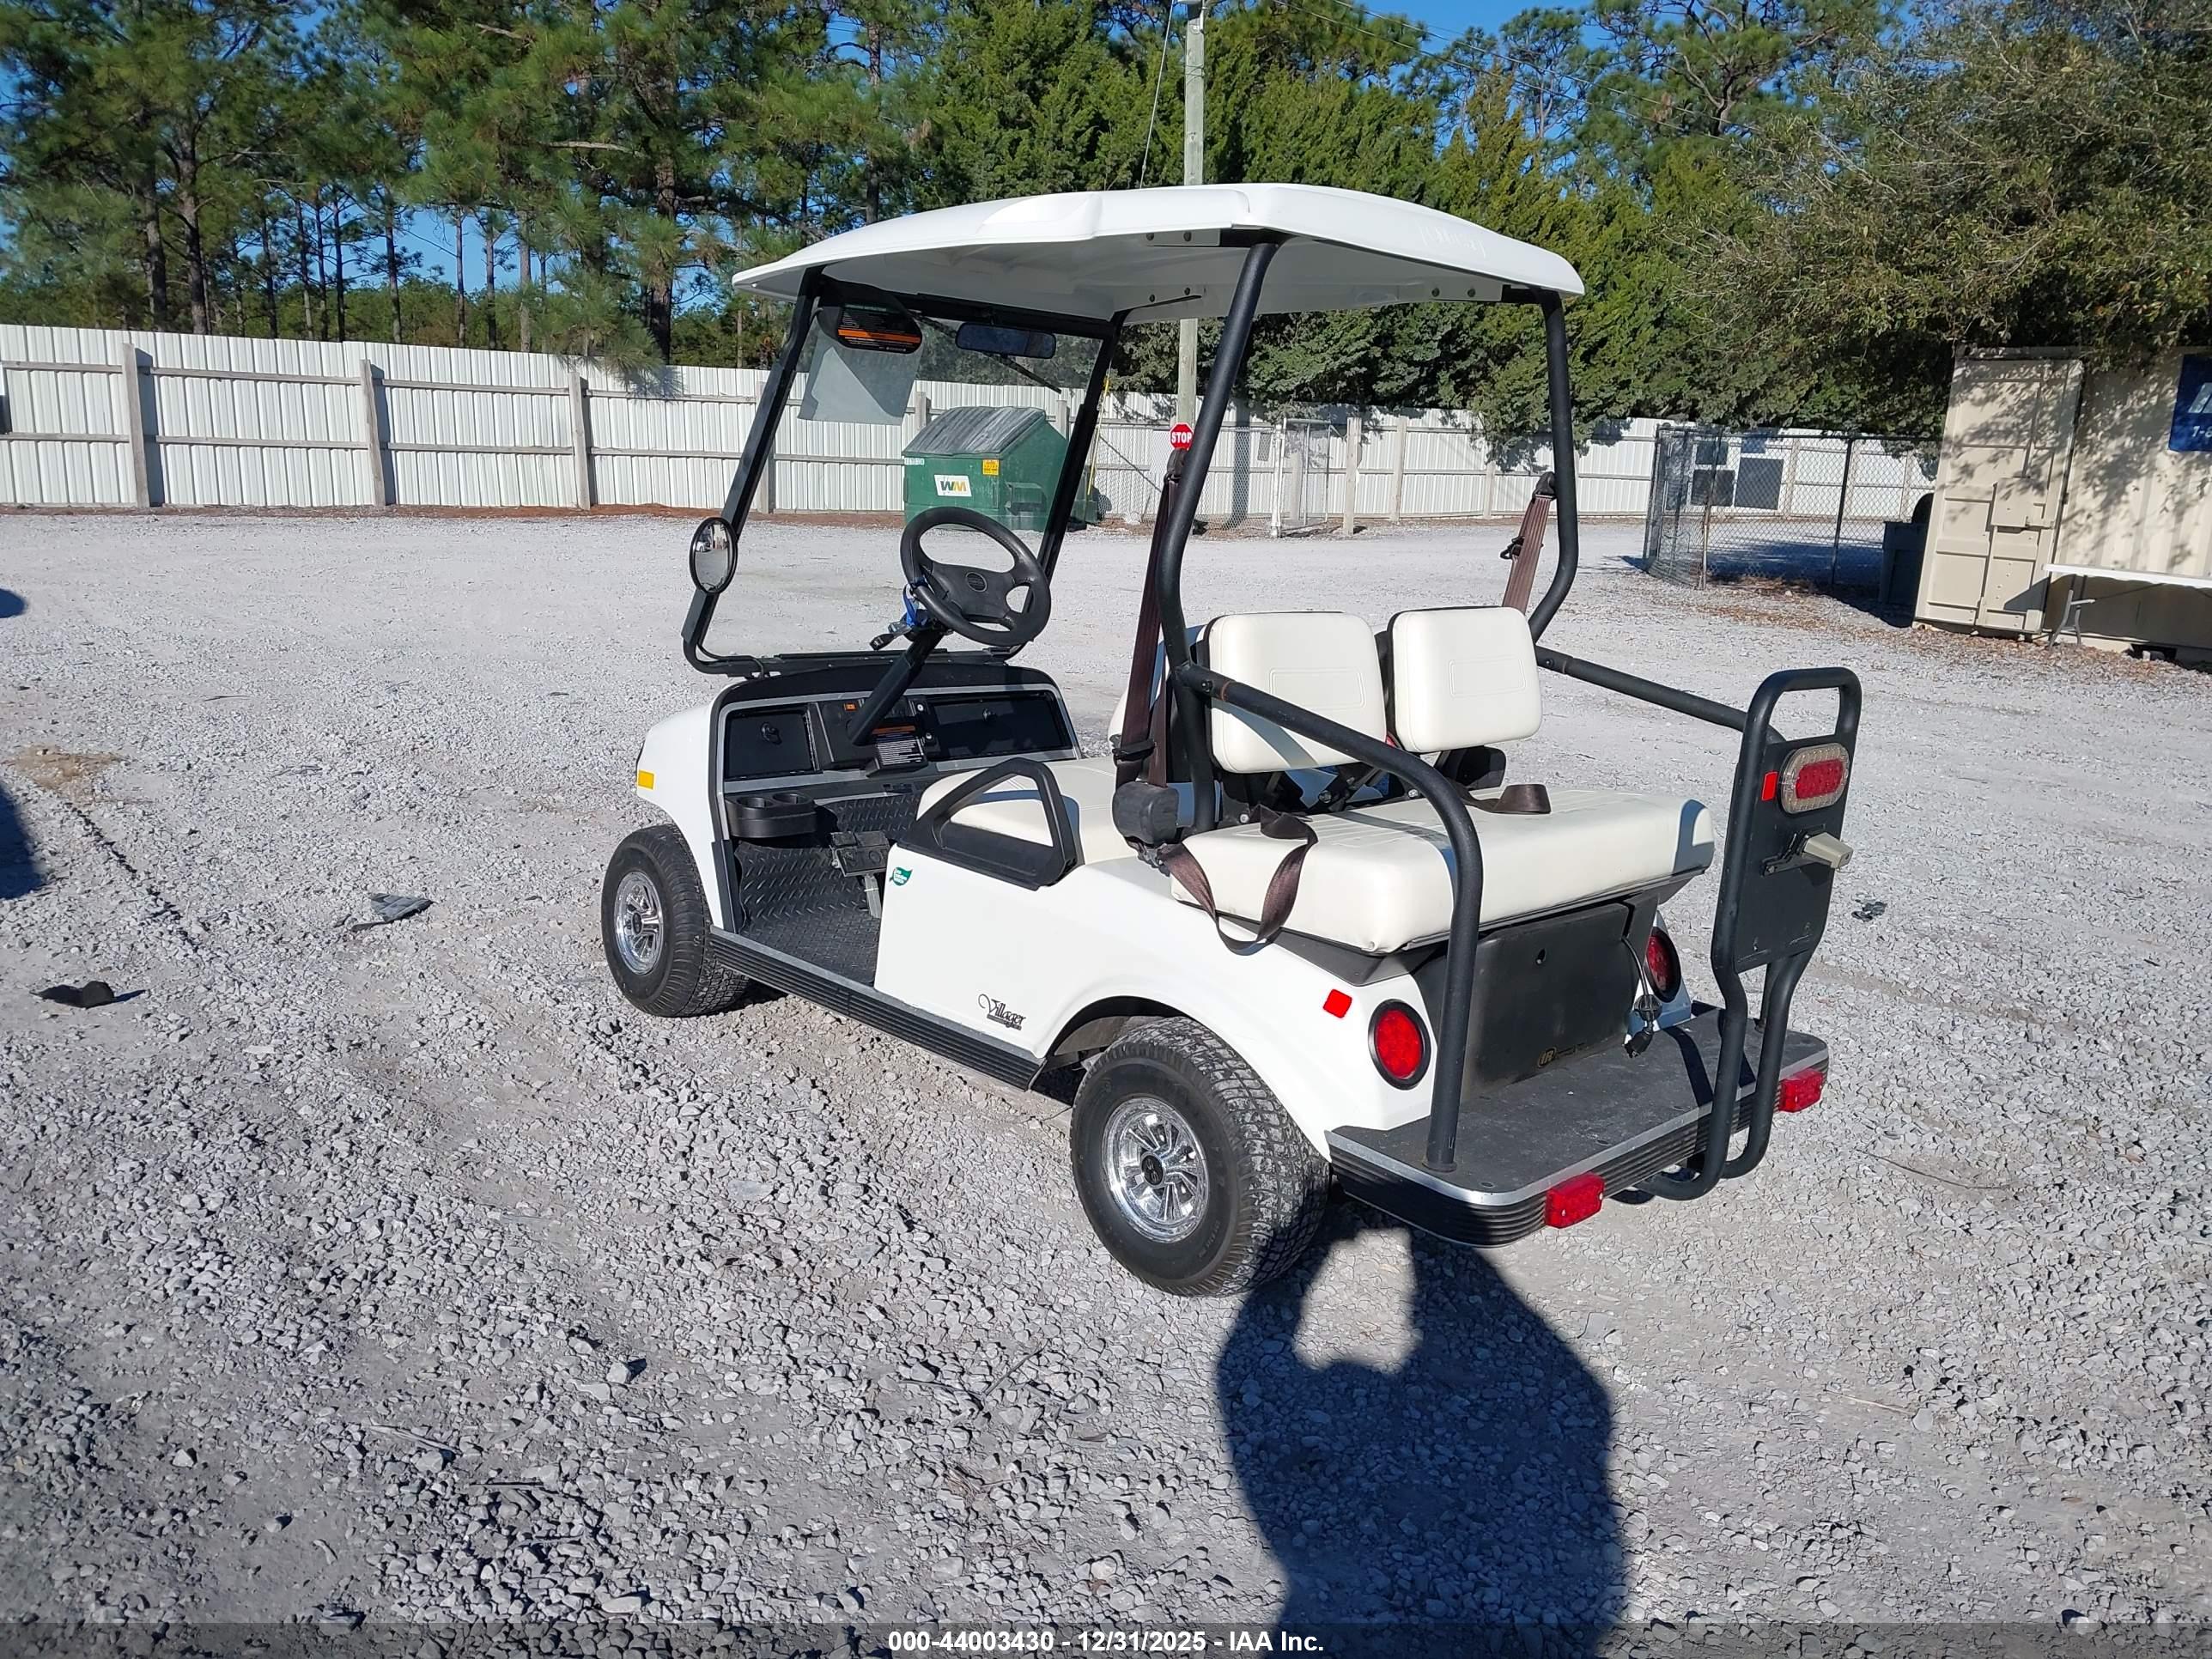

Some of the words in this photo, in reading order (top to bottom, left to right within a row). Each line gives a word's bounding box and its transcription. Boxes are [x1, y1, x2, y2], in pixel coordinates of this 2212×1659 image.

[1171, 431, 1192, 444] STOP
[940, 480, 967, 492] WM
[978, 994, 1026, 1026] Villager
